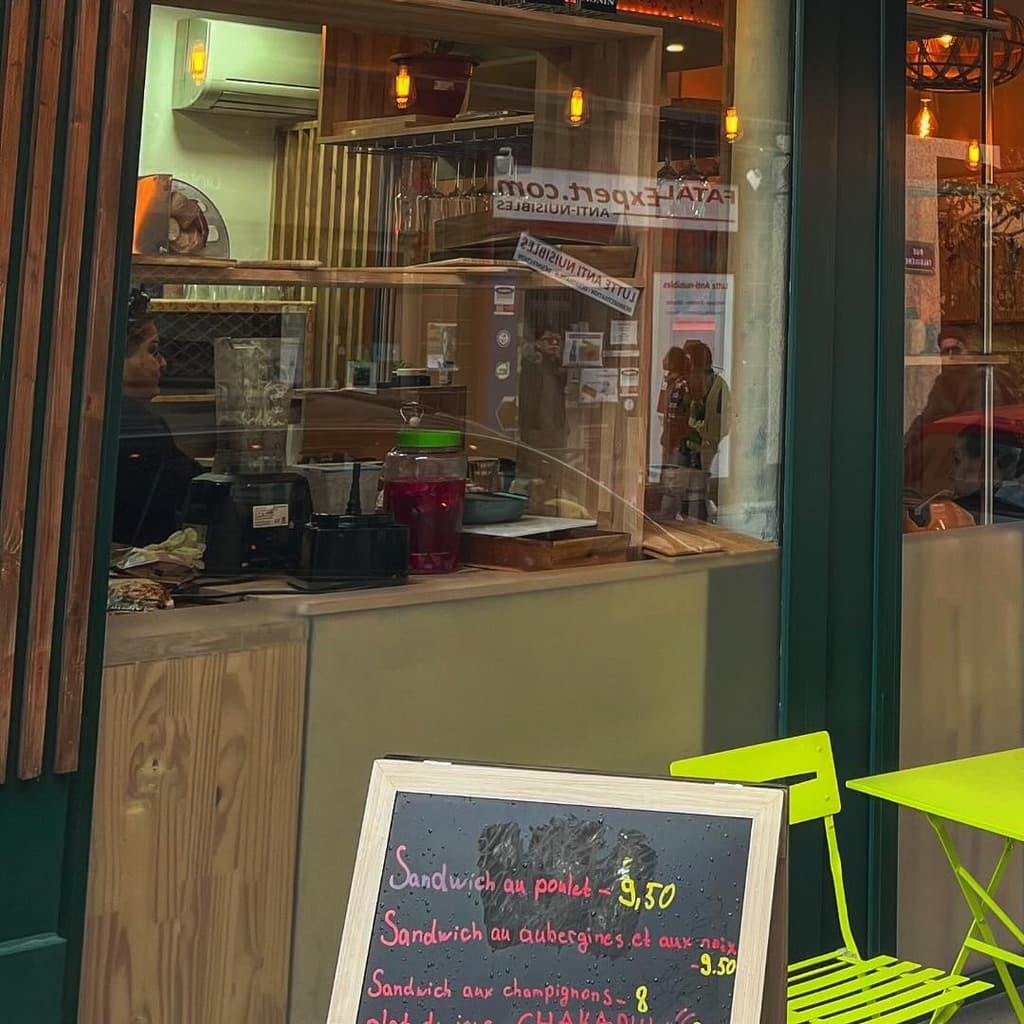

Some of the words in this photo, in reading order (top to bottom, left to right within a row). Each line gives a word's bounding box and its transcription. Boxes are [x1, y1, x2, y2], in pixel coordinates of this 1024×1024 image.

[389, 845, 496, 892] Sandwich
[503, 877, 525, 894] au
[534, 872, 592, 900] poulet
[618, 878, 676, 911] 9,50
[380, 909, 483, 947] Sandwich
[490, 931, 511, 942] au
[518, 921, 625, 954] aubergines
[631, 926, 651, 948] et
[659, 935, 693, 950] aux
[367, 968, 451, 998] Sandwich
[462, 985, 494, 999] aux
[503, 977, 613, 1008] champignons
[635, 985, 649, 1013] 8
